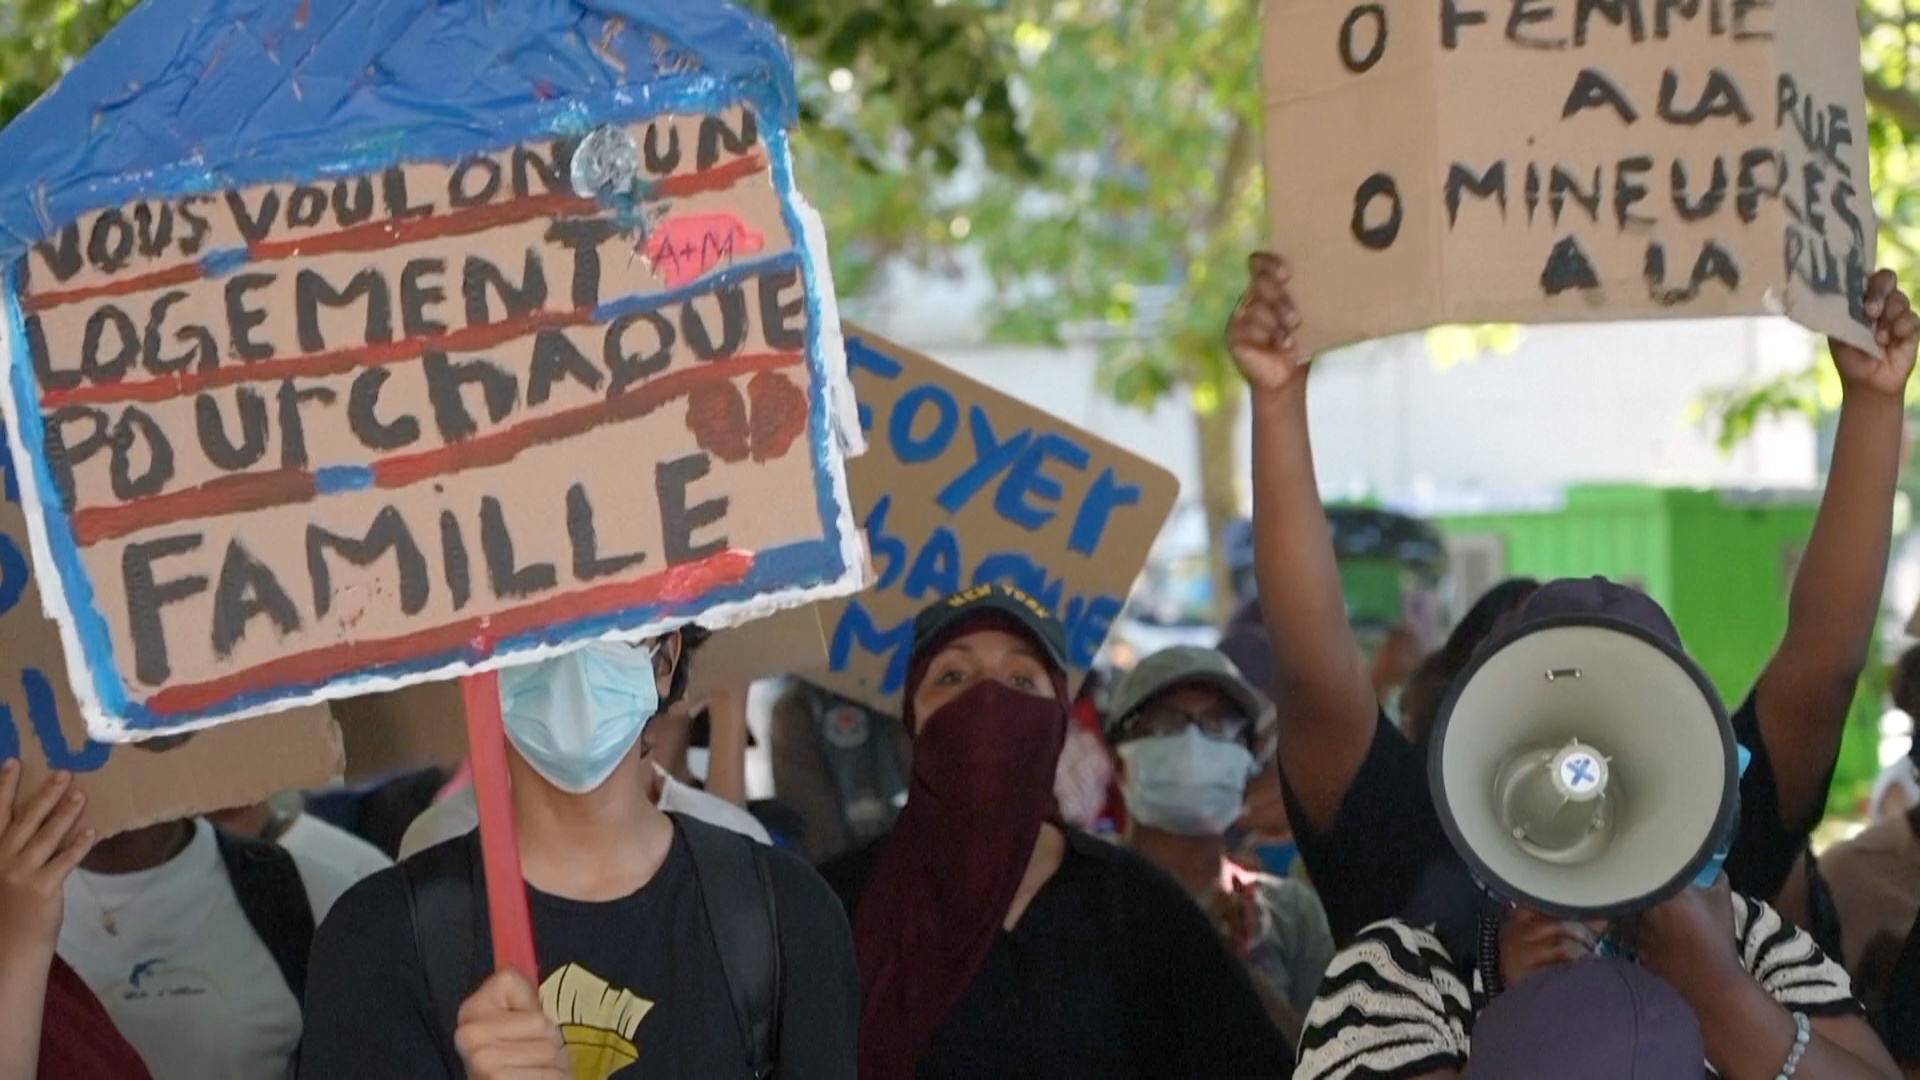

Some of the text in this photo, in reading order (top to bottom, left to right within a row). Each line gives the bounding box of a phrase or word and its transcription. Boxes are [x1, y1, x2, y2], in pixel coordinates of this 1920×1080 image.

[644, 107, 757, 174] UN
[1560, 67, 1852, 180] A LA RUE
[27, 213, 632, 389] LOGEMENT
[1540, 233, 1603, 304] A
[1643, 239, 1740, 306] LA
